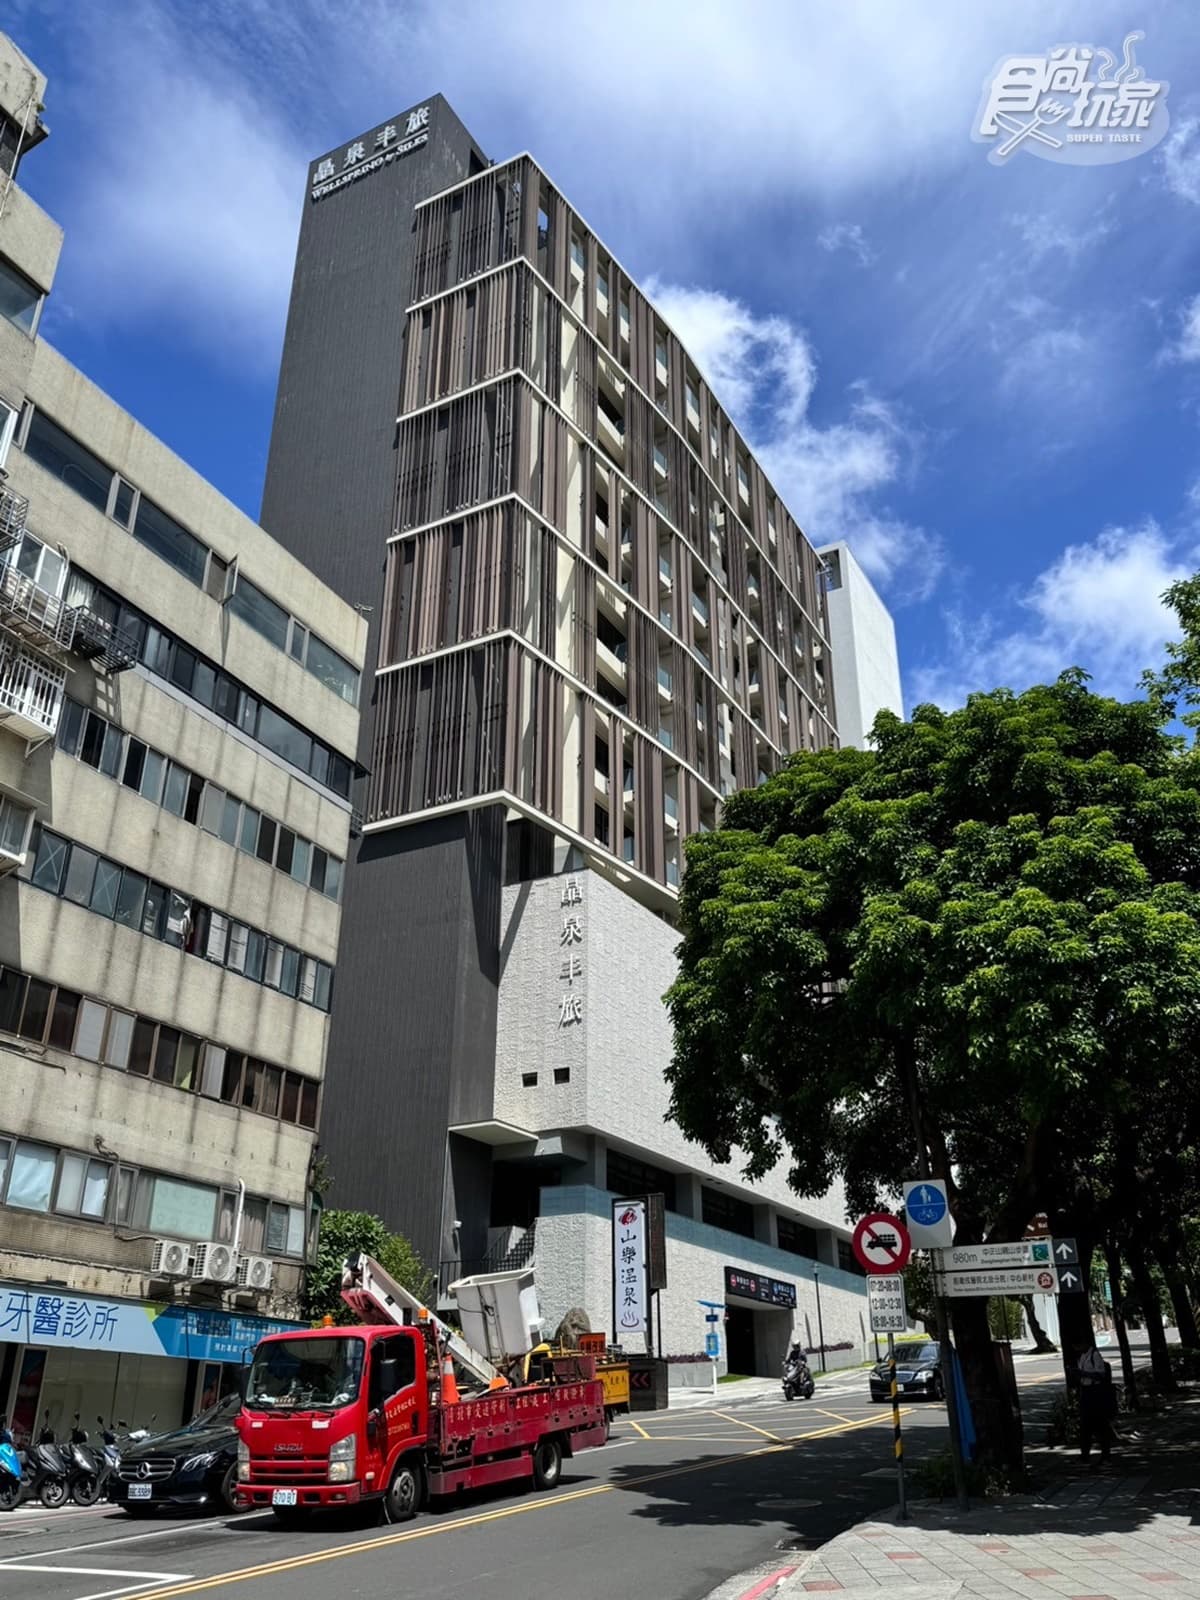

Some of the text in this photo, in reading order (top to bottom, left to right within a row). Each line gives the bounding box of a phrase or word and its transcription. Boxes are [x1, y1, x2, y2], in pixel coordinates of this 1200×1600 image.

[312, 106, 430, 185] 晶泉丰旅
[311, 156, 384, 200] WELLSPRING
[559, 876, 583, 1029] 晶泉丰旅
[953, 1252, 978, 1264] 980m
[0, 1293, 119, 1341] 牙醫診所
[274, 1443, 303, 1452] ISUZU
